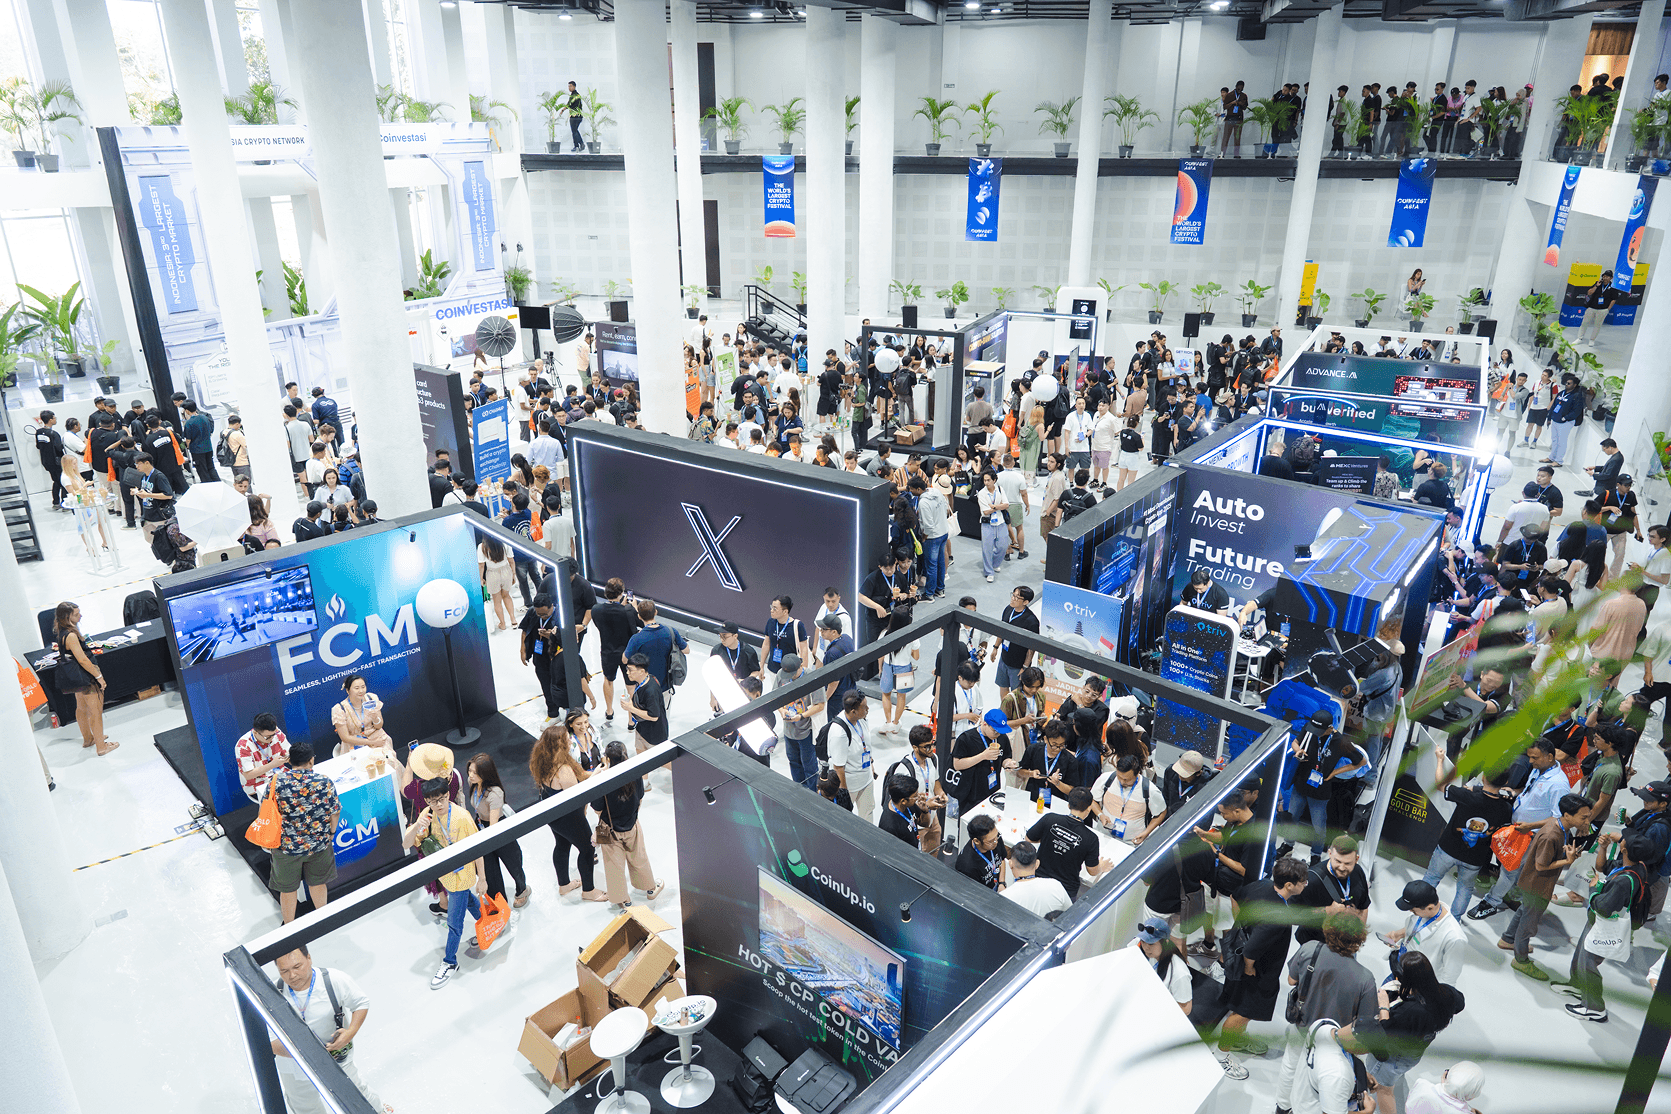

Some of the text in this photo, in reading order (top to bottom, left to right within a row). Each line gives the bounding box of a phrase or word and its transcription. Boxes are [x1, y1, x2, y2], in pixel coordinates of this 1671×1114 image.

[272, 136, 305, 144] NETWORK
[149, 185, 165, 231] LARGEST
[163, 202, 186, 283] CRYPTO MARKET
[436, 298, 512, 320] COINVESTASI
[425, 399, 445, 410] products
[1193, 490, 1265, 521] Auto
[1191, 510, 1246, 534] Invest
[680, 502, 743, 592] X
[1189, 538, 1284, 578] Future
[1186, 559, 1255, 590] Trading
[1074, 604, 1096, 618] triv
[276, 603, 419, 685] FCM
[1206, 624, 1227, 637] triv
[1170, 660, 1188, 669] 1000+
[1190, 667, 1204, 675] Crypto
[1172, 648, 1188, 657] Trading
[284, 647, 421, 695] SEAMLESS, LIGHTNING-FAST TRANSACTION
[1389, 806, 1426, 824] CHALLENGE
[1390, 799, 1428, 818] GOLD BAR
[333, 817, 379, 848] CM
[811, 866, 876, 914] CoinUp.io
[738, 944, 899, 1062] HOT $ CP COLD VA
[763, 979, 784, 997] Scoop
[785, 994, 796, 1006] the
[797, 1001, 808, 1015] hot
[810, 1010, 823, 1025] test
[824, 1021, 844, 1041] token
[845, 1036, 852, 1047] in
[854, 1042, 865, 1056] the
